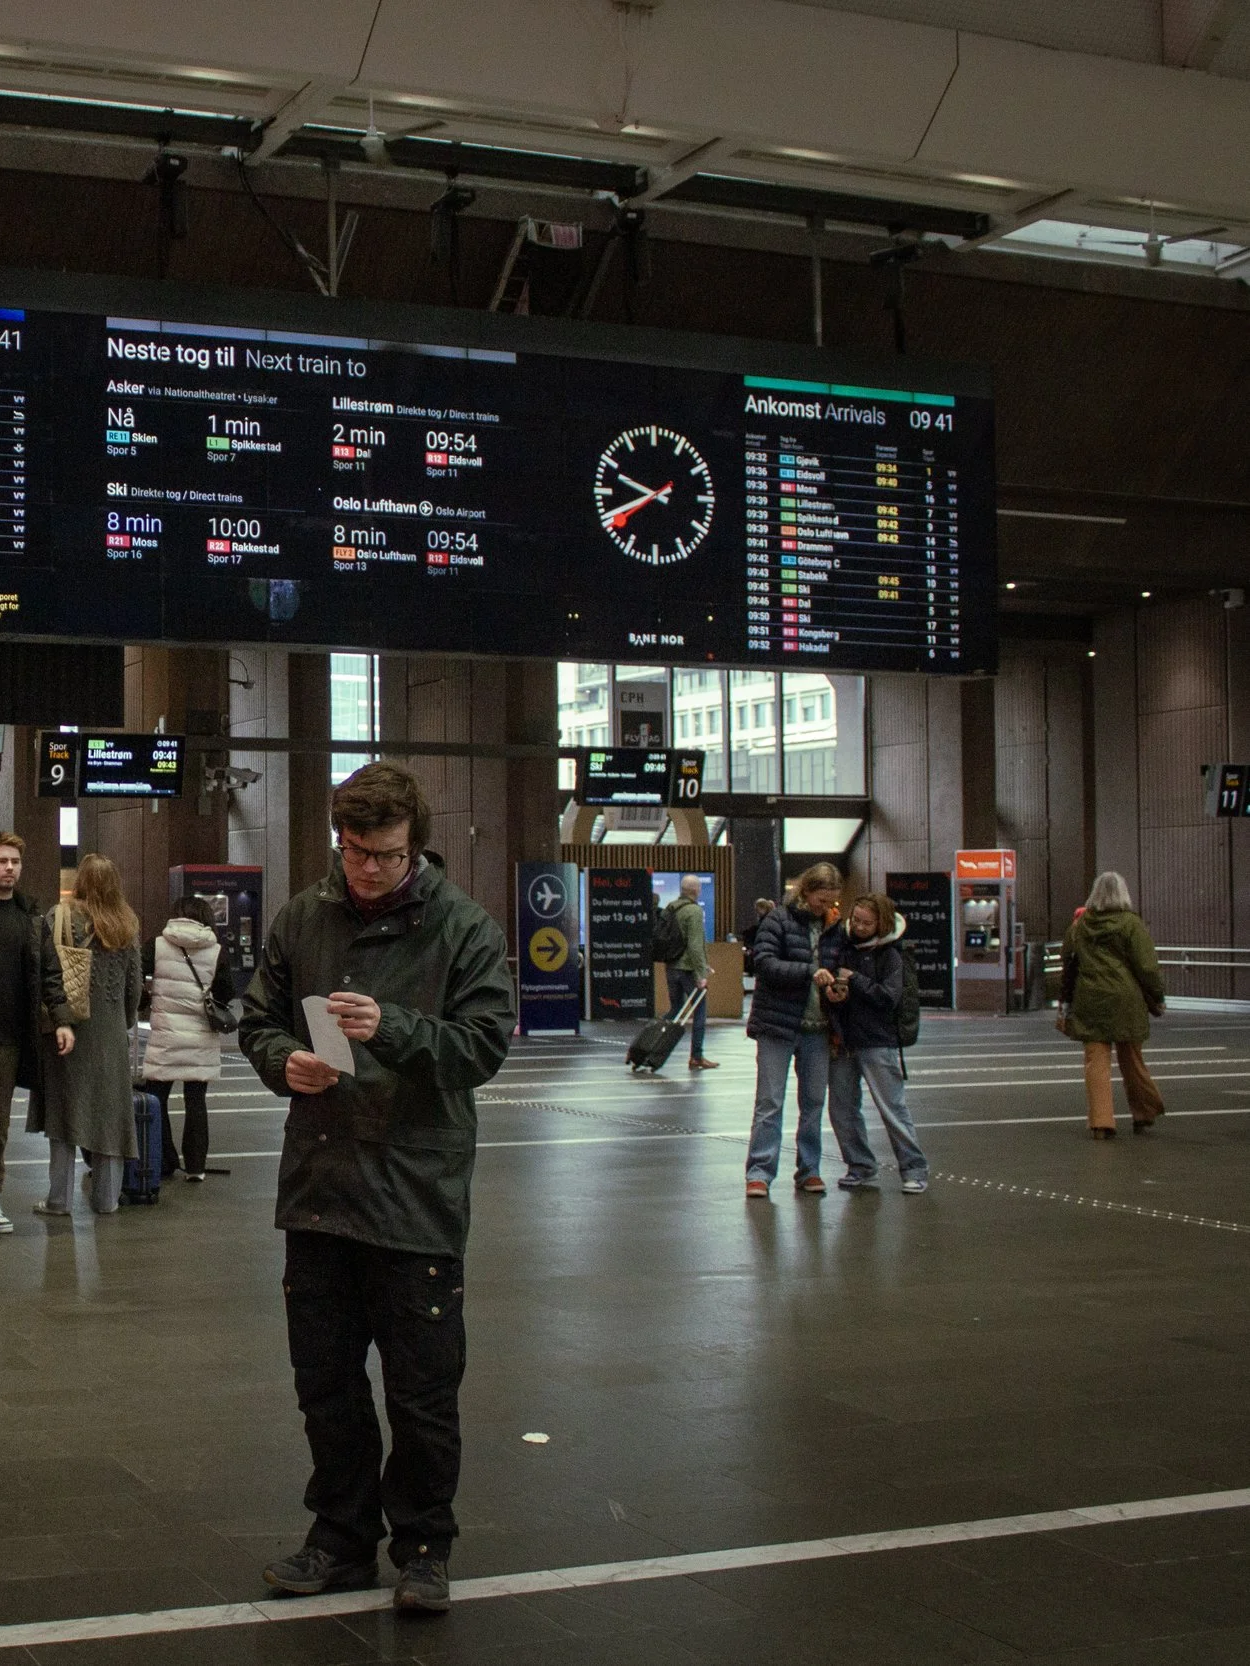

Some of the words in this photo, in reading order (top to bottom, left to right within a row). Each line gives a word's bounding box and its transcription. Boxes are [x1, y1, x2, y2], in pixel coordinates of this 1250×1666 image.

[107, 338, 170, 361] Neste
[176, 344, 209, 369] tog
[216, 347, 234, 367] til
[246, 349, 292, 371] Next
[298, 355, 341, 375] train
[347, 359, 366, 377] to
[107, 380, 144, 394] Asker
[148, 386, 161, 395] via
[165, 388, 235, 401] Nationaltheatret
[244, 394, 277, 405] Lysaker
[333, 397, 393, 414] Lillestrøm
[397, 405, 426, 416] Direkte
[428, 409, 441, 419] tog
[450, 409, 474, 420] Direct
[476, 411, 499, 422] trains
[745, 395, 821, 419] Ankomst
[825, 404, 886, 425] Arrivals
[910, 411, 930, 429] 09
[935, 413, 953, 431] 41
[108, 408, 134, 427] Nå
[225, 418, 260, 436] min
[132, 433, 157, 443] Skien
[350, 427, 385, 445] min
[426, 431, 476, 452] 09:54
[107, 445, 128, 456] Spor
[232, 440, 281, 452] Spikkestad
[207, 451, 228, 462] Spor
[335, 448, 348, 456] R13
[357, 448, 371, 458] Dal
[333, 460, 355, 471] Spor
[107, 483, 127, 496] Ski
[131, 488, 164, 498] Direkte
[166, 491, 180, 501] tog
[190, 491, 215, 501] Direct
[218, 493, 242, 502] trains
[334, 497, 360, 510] Oslo
[364, 499, 417, 514] Lufthavn
[436, 507, 454, 516] Oslo
[457, 508, 485, 518] Airport
[126, 514, 162, 532] min
[208, 518, 260, 538] 10:00
[110, 537, 123, 545] R21
[133, 538, 157, 547] Moss
[428, 531, 478, 551] 09:54
[107, 549, 128, 560] Spor
[131, 550, 142, 559] 16
[232, 543, 279, 554] Rakkestad
[208, 554, 228, 564] Spor
[232, 555, 241, 564] 17
[357, 549, 378, 559] Oslo
[380, 551, 416, 561] Lufthavn
[450, 555, 483, 566] Eidsvoll
[334, 561, 353, 571] Spor
[357, 562, 366, 570] 13
[629, 633, 656, 646] BANE
[661, 635, 684, 645] NOR
[621, 692, 644, 703] CPH
[49, 742, 67, 751] Spor
[50, 751, 69, 759] Track
[88, 750, 132, 759] Lillestrøm
[153, 751, 176, 760] 09:41
[590, 762, 602, 771] Ski
[51, 764, 64, 786] 9
[678, 779, 698, 798] 10
[1222, 790, 1237, 808] 11
